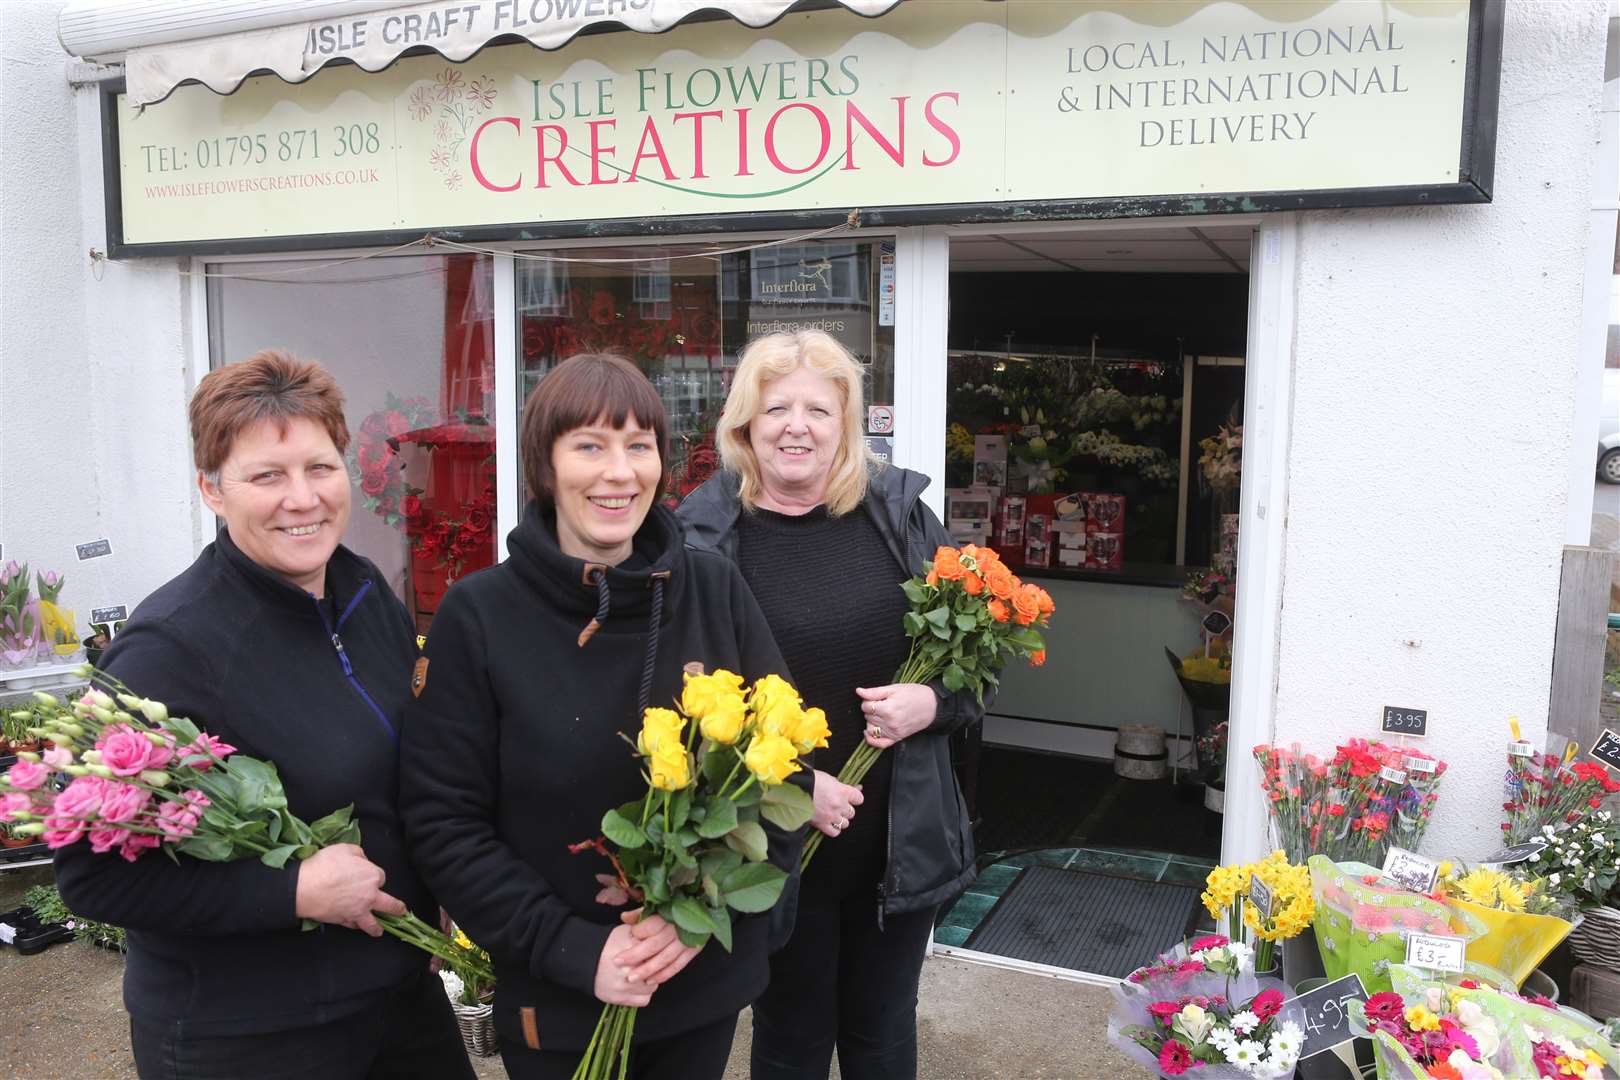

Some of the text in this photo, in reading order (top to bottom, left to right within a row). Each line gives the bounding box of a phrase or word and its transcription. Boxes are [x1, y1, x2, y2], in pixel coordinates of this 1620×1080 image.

[311, 21, 368, 54] ISLE
[382, 5, 481, 44] CRAFT
[1066, 22, 1404, 73] LOCAL, NATIONAL
[531, 55, 860, 121] ISLE FLOWERS
[1057, 64, 1409, 113] & INTERNATIONAL
[196, 134, 267, 168] 01795
[278, 129, 320, 161] 871
[334, 122, 380, 157] 308
[470, 92, 960, 192] CREATIONS
[1139, 112, 1317, 147] DELIVERY
[145, 169, 379, 198] WWW.ISLEFLOWERSCREATIONS.CO.UK
[761, 279, 817, 294] Interflora
[747, 318, 845, 334] Interflora orders
